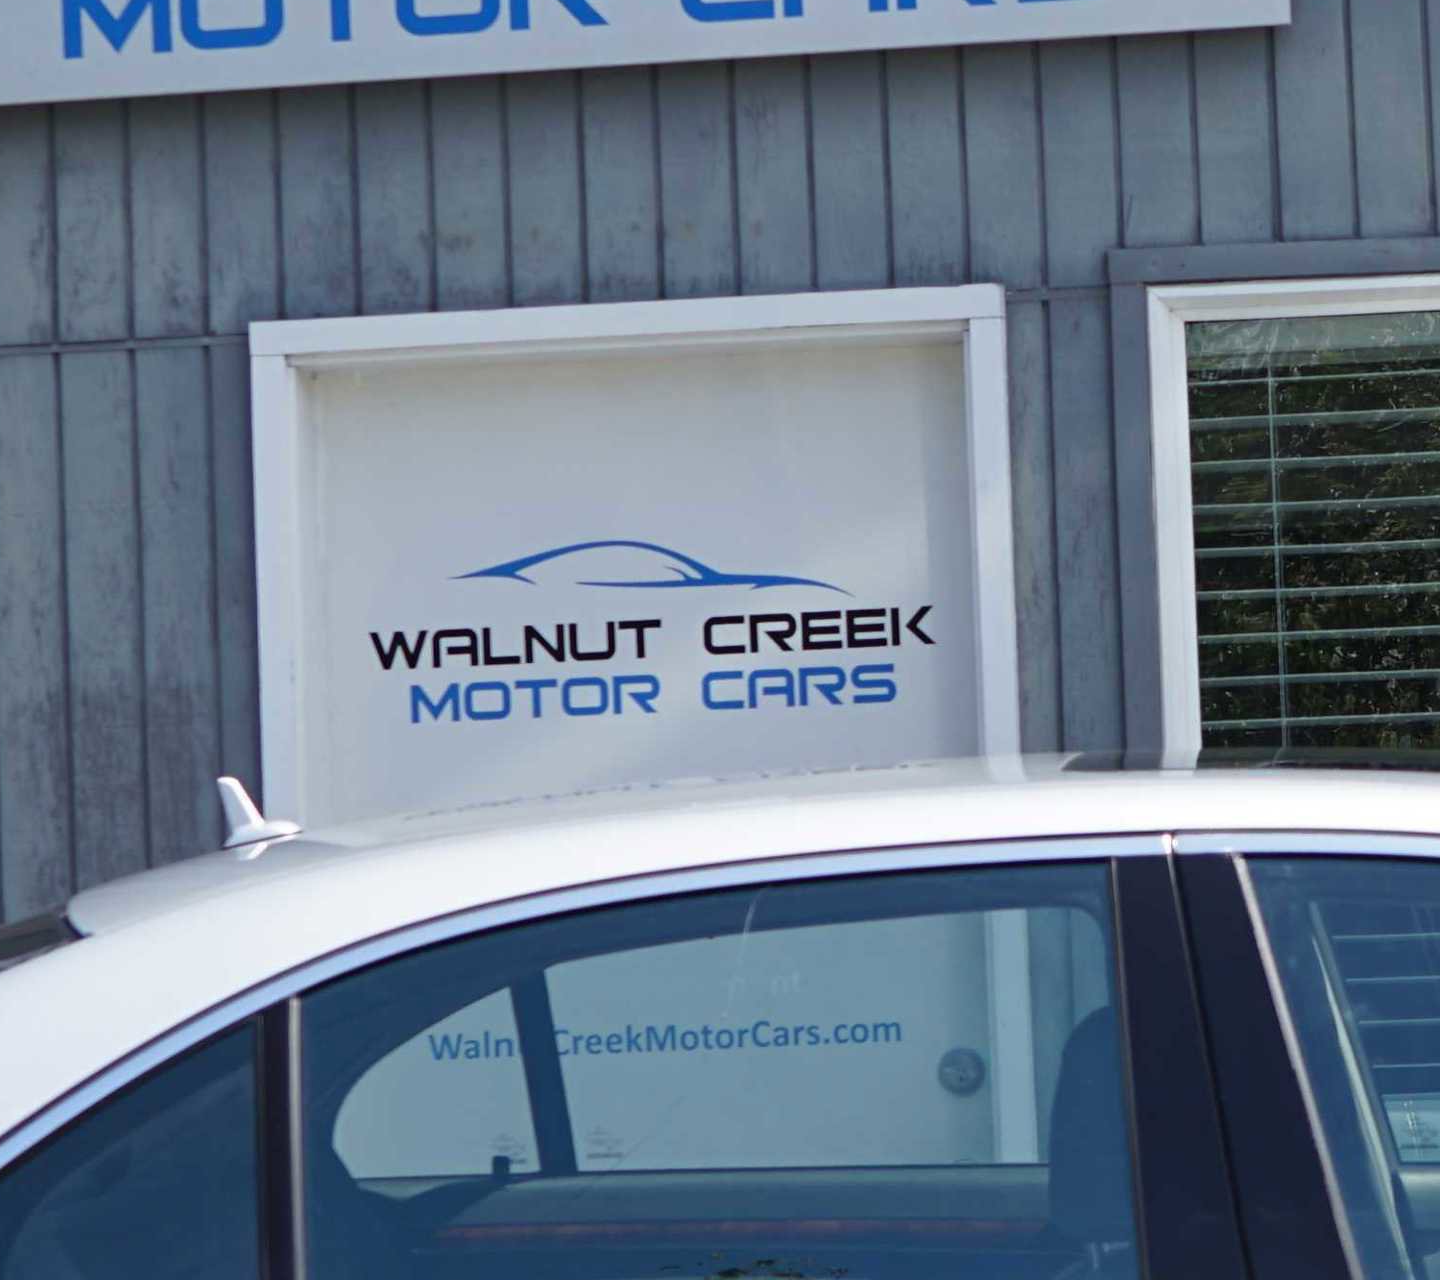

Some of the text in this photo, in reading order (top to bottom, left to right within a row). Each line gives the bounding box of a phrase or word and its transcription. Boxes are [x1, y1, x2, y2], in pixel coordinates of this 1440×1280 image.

[369, 604, 936, 671] WALNUT CREEK
[409, 661, 899, 725] MOTOR CARS
[427, 1019, 903, 1062] WalnCreekMotorCars.com
